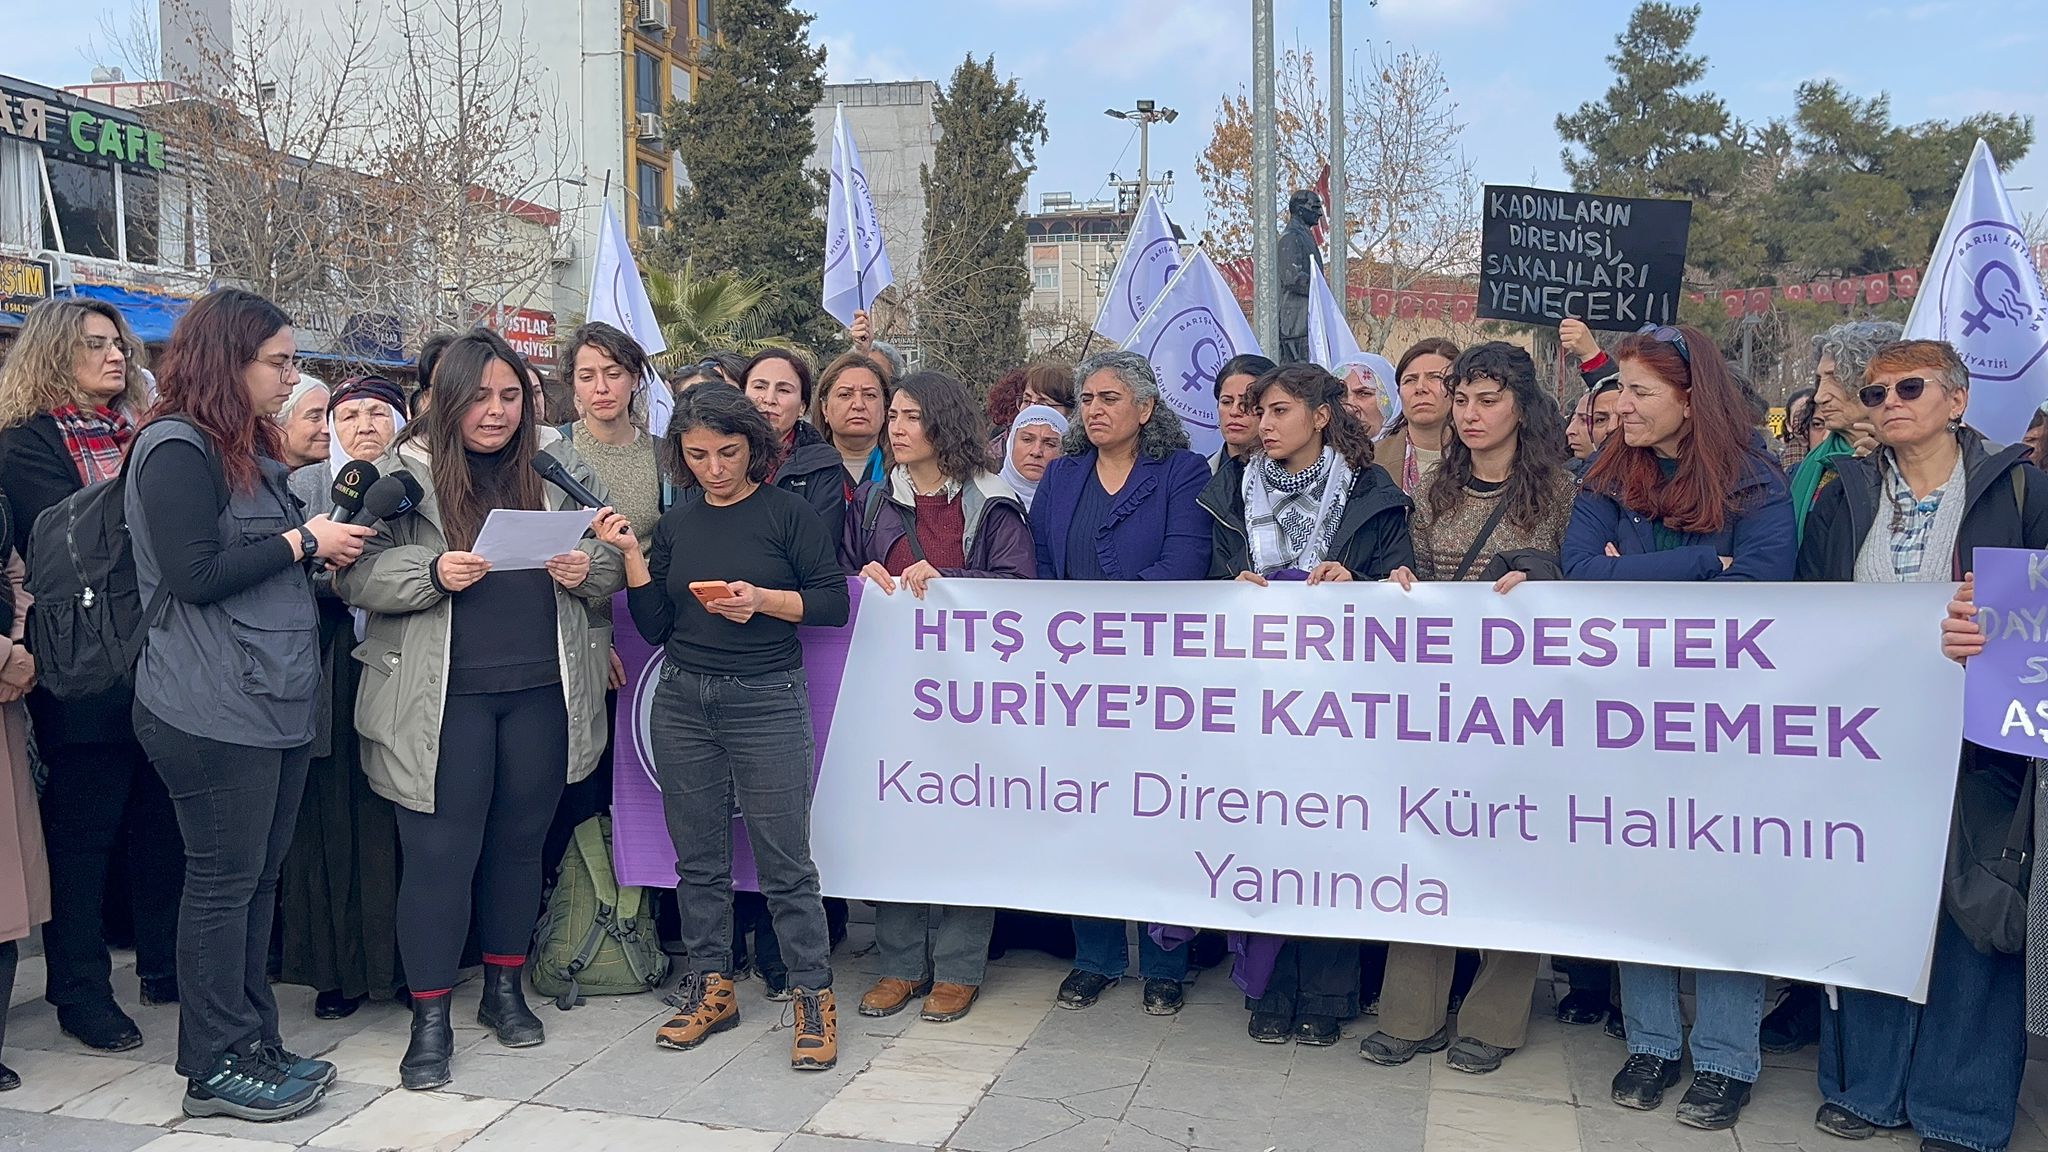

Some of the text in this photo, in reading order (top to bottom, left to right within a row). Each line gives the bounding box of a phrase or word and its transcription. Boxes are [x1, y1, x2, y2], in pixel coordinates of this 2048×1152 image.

[70, 111, 165, 169] CAFE
[1491, 192, 1631, 228] KADINLARIN
[863, 231, 876, 249] VAR
[1150, 246, 1174, 262] BARIŞA
[1510, 222, 1624, 266] DİRENİŞİ,
[0, 260, 46, 298] ŞİM
[1486, 253, 1649, 289] SAKALILARI
[1959, 233, 1998, 257] BARIŞA
[2029, 306, 2047, 332] VAR
[1179, 316, 1212, 331] BARIŞA
[1155, 365, 1168, 393] KADIN
[915, 604, 1777, 670] HTŞ ÇETELERİNE DESTEK
[1978, 606, 2048, 643] DAY
[1262, 683, 1564, 747] KATLİAM
[1596, 700, 1881, 760] DEMEK
[879, 760, 1865, 863] Kadınlar Direnen Kürt Halkının
[1194, 850, 1449, 917] Yanında
